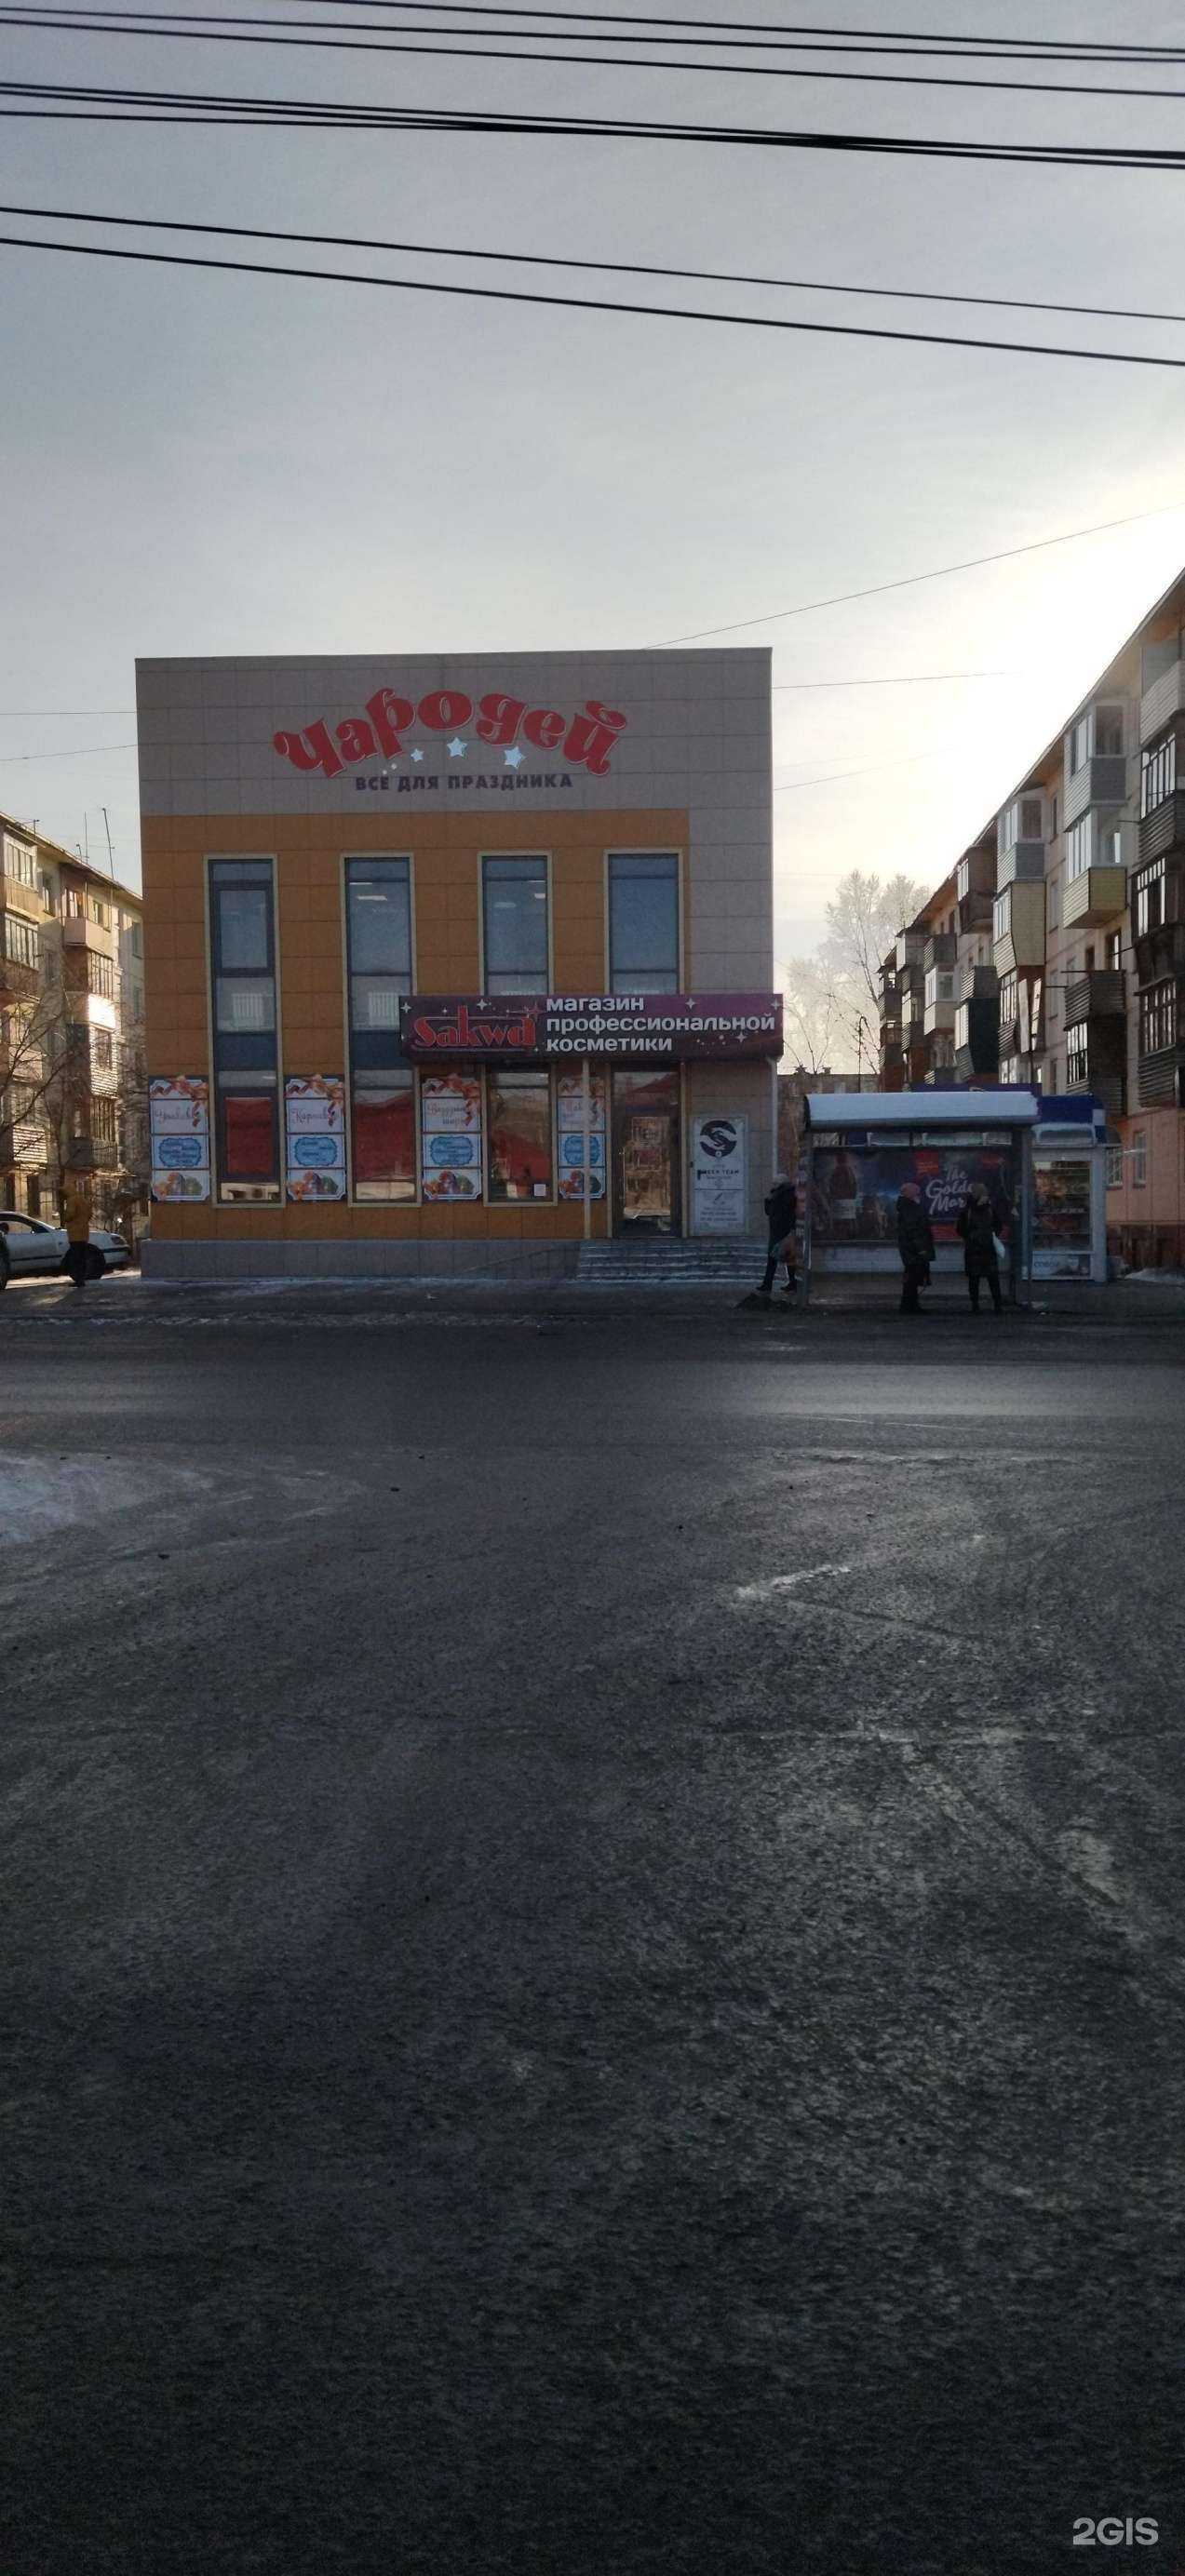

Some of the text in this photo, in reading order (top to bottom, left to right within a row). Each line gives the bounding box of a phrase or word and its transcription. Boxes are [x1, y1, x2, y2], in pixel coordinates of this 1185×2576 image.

[274, 688, 627, 779] Чародей
[356, 773, 572, 792] ВСЕ ДЛЯ ПРАЗДНИКА
[546, 997, 644, 1012] магазин
[546, 1013, 775, 1035] профессиональной
[546, 1037, 673, 1052] косметики
[945, 1165, 968, 1181] The
